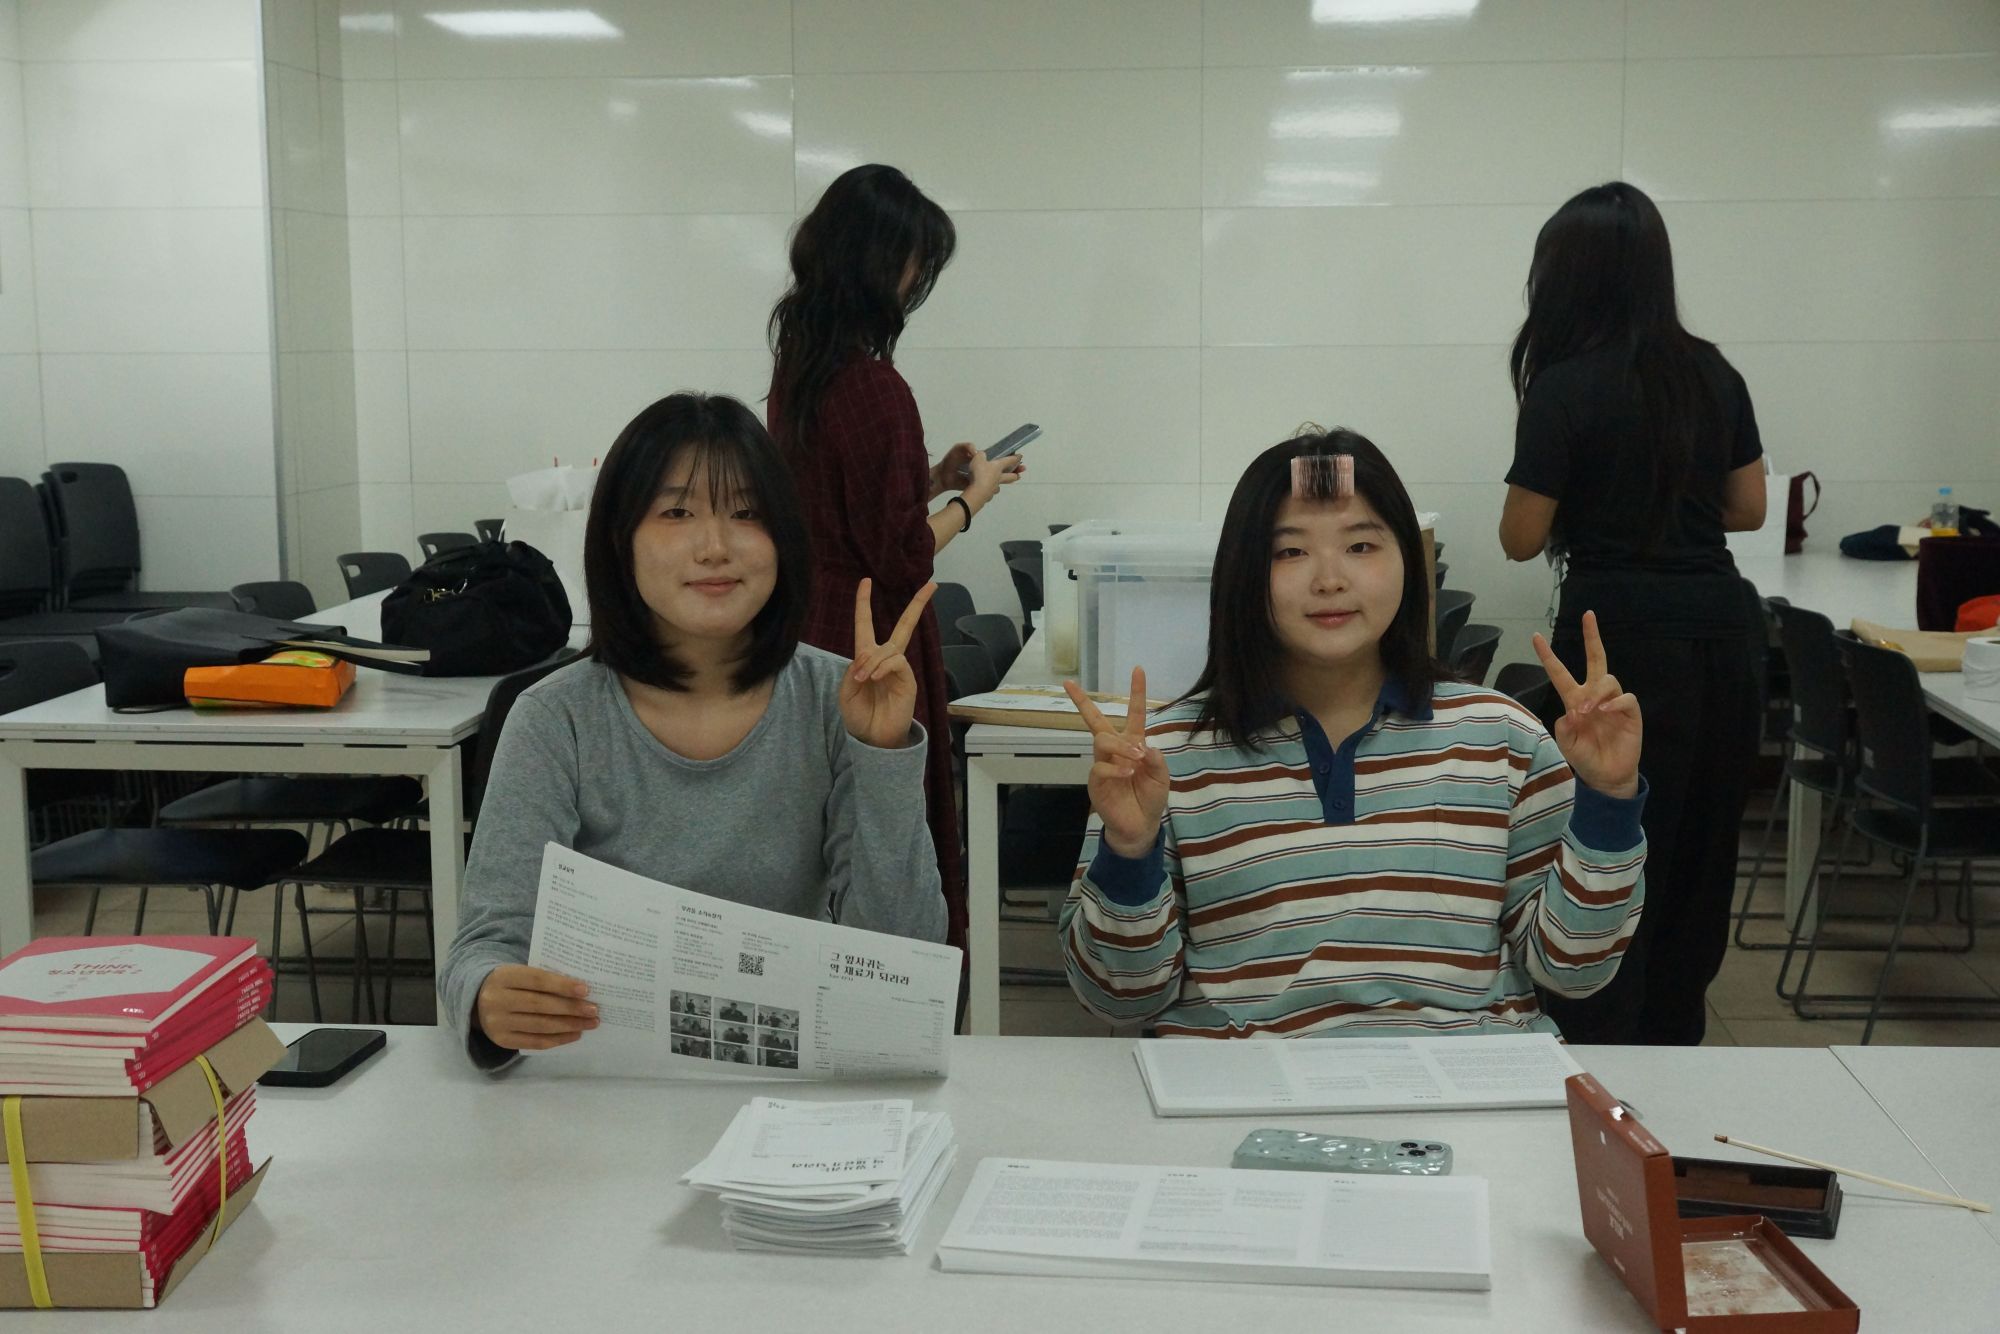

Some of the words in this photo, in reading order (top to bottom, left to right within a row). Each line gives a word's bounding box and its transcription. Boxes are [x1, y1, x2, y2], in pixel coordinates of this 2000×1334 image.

[831, 952, 840, 962] 그
[845, 954, 885, 970] 잎사귀는
[830, 963, 839, 973] 약
[844, 966, 874, 980] 재료가
[879, 972, 910, 986] 되리라
